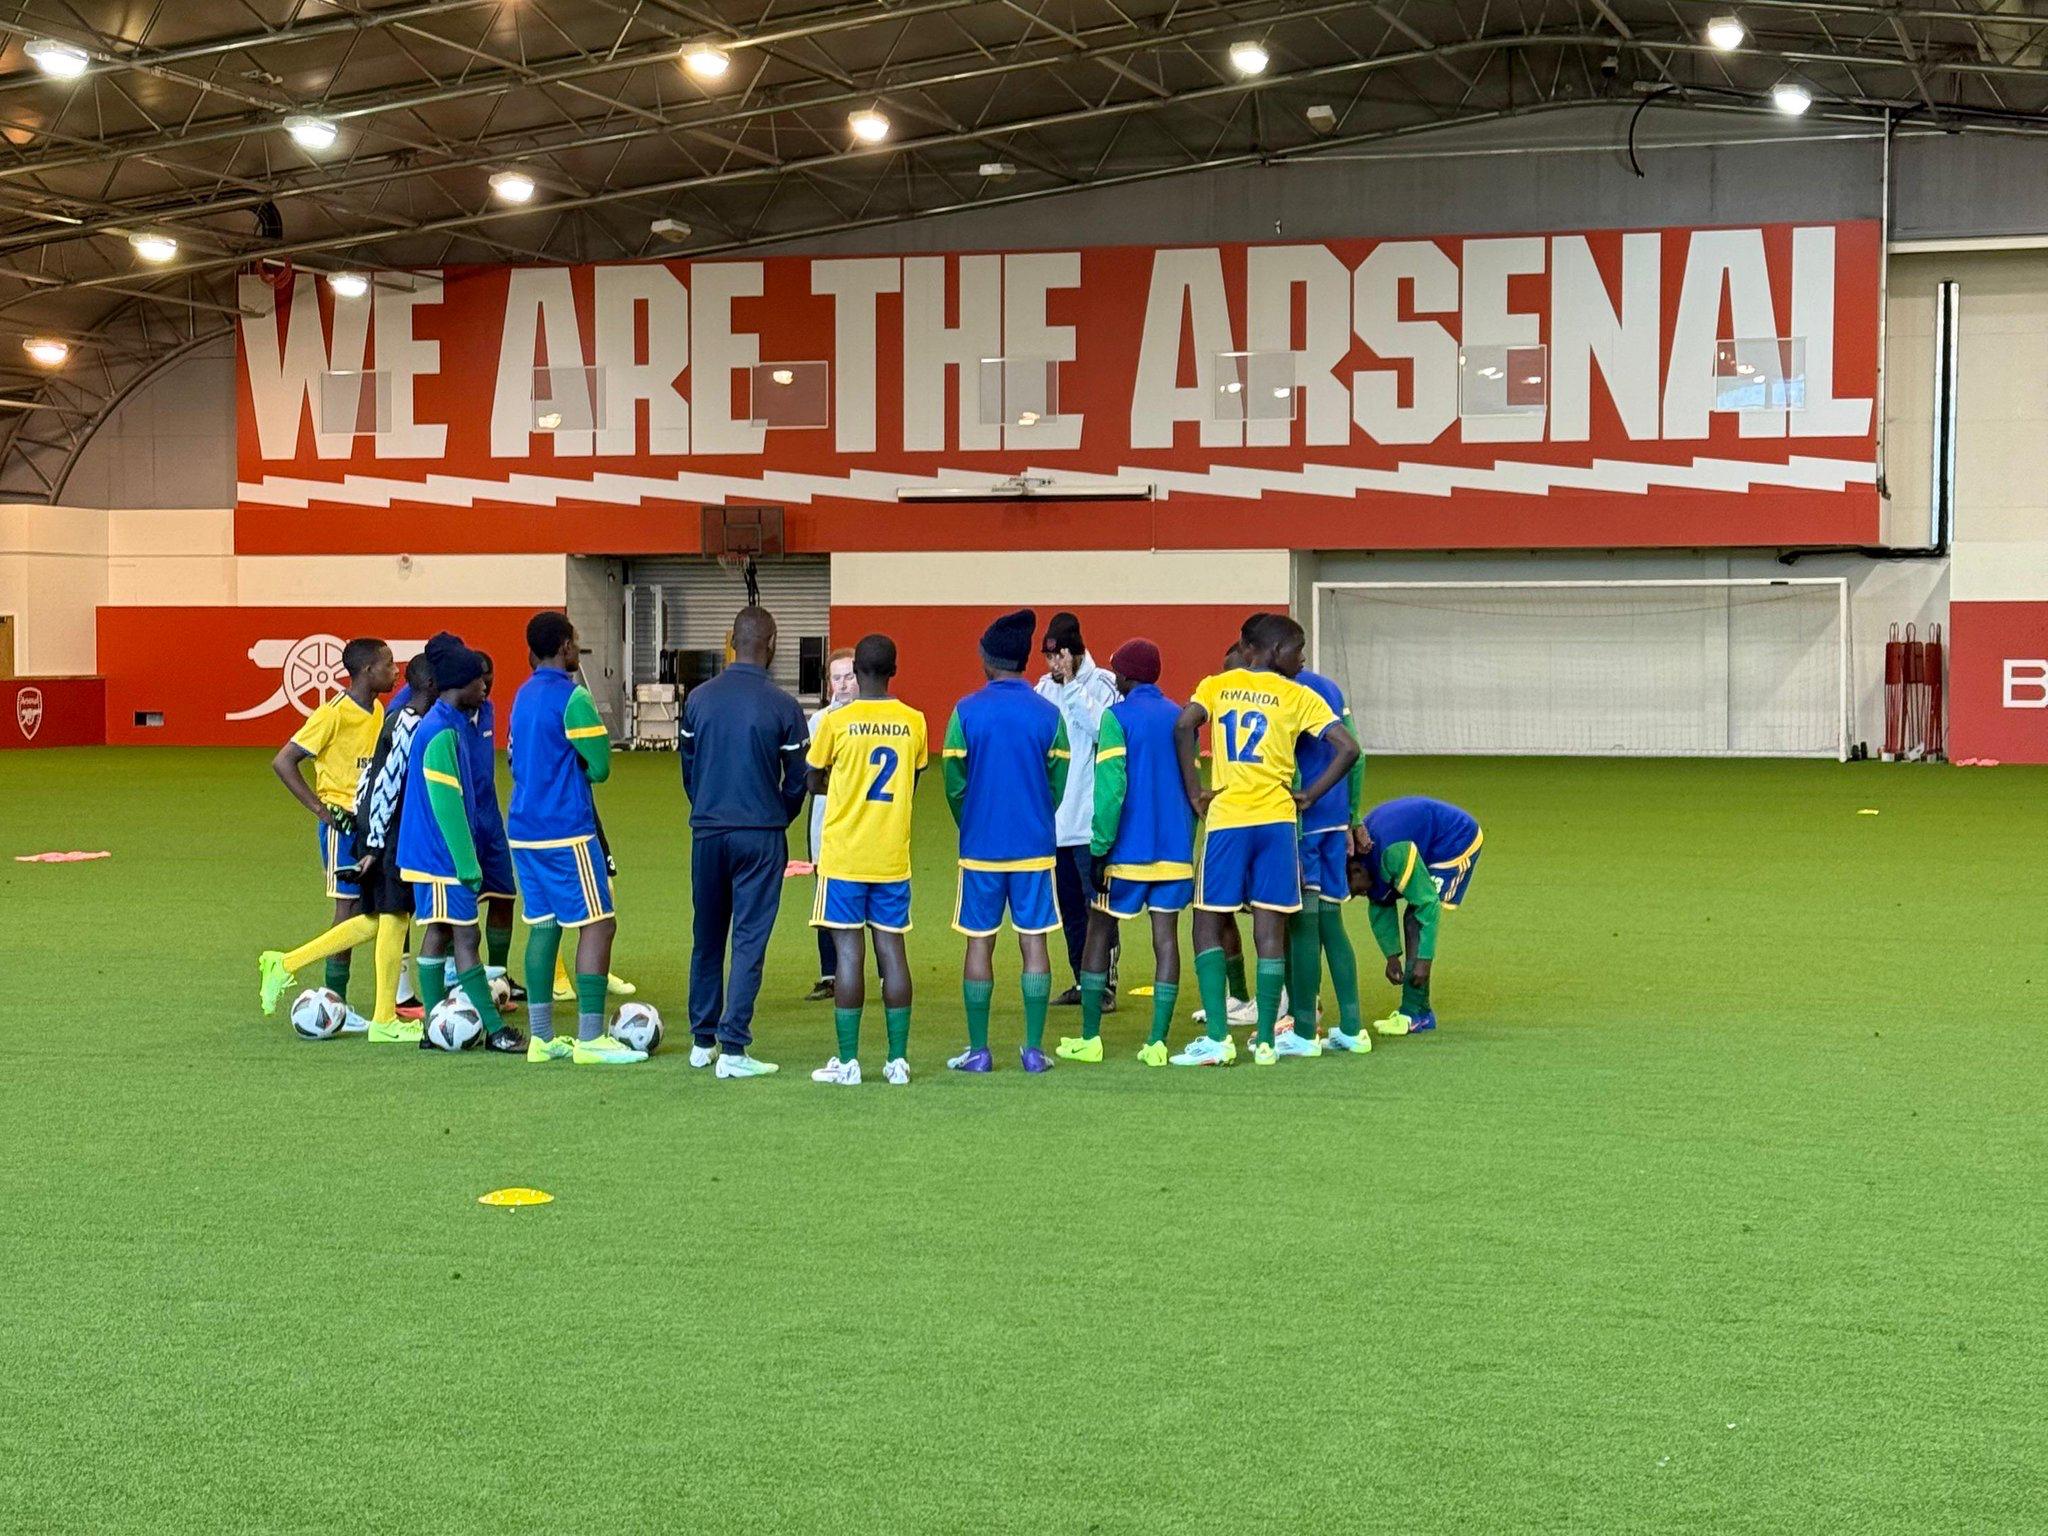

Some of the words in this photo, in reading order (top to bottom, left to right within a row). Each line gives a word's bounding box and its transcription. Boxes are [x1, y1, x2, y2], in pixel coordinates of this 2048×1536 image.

[238, 269, 448, 460] WE
[491, 262, 768, 457] ARE
[810, 252, 1083, 452] THE
[1130, 227, 1873, 448] ARSENAL
[1219, 688, 1280, 707] RWANDA
[2003, 659, 2048, 708] B
[849, 723, 911, 737] RWANDA
[1218, 709, 1268, 763] 12
[866, 746, 899, 802] 2
